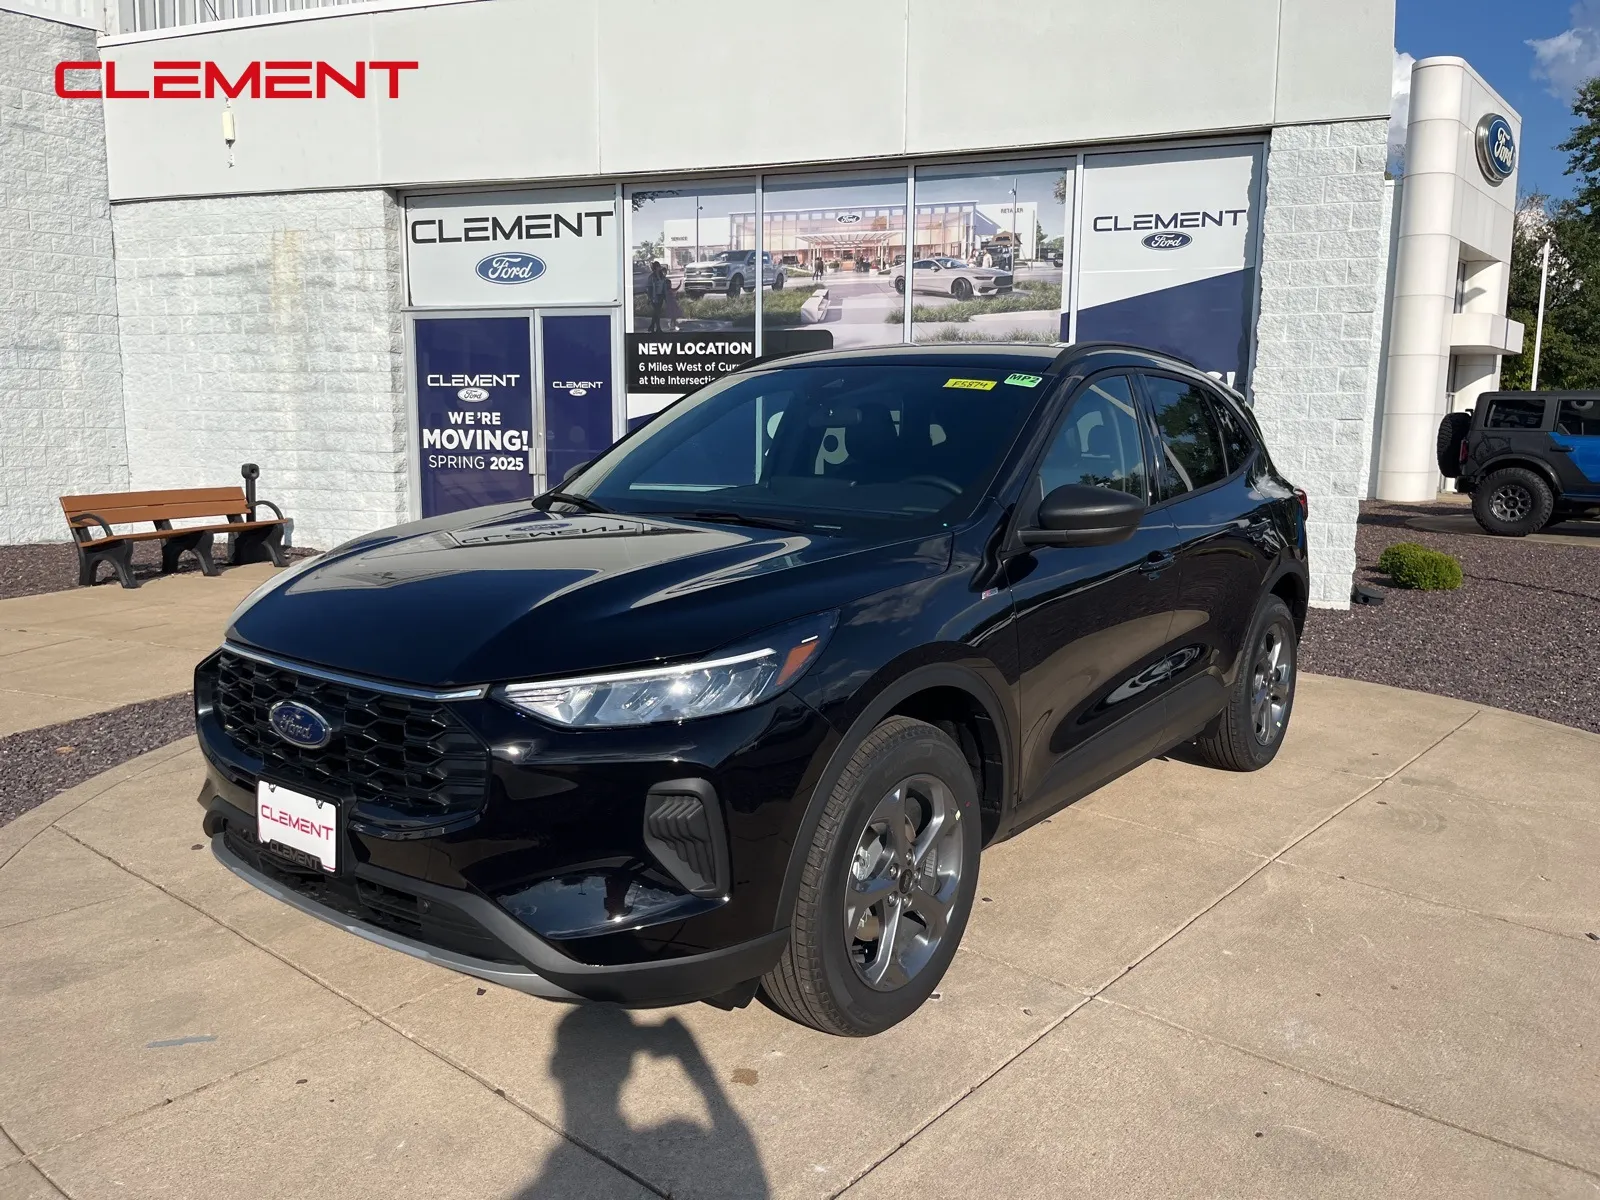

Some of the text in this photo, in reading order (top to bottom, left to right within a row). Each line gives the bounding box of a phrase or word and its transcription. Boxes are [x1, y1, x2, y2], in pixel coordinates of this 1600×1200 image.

[1494, 127, 1514, 168] Ford
[411, 211, 614, 244] CLEMENT
[1093, 209, 1247, 233] CLEMENT
[1151, 234, 1182, 248] Ford
[488, 256, 533, 279] Ford
[638, 342, 752, 355] NEW LOCATION
[639, 362, 646, 372] 6
[648, 362, 673, 372] Miles
[676, 362, 702, 372] West
[704, 361, 715, 372] of
[427, 374, 520, 387] CLEMENT
[552, 381, 604, 389] CLEMENT
[639, 376, 648, 385] at
[651, 375, 666, 385] the
[1009, 373, 1040, 384] MP2
[463, 389, 483, 400] Ford
[448, 411, 501, 425] WE'RE
[422, 428, 529, 452] MOVING!
[428, 455, 524, 471] SPRING 2025
[280, 711, 313, 740] Ford
[261, 804, 334, 841] CLEMENT
[270, 840, 319, 870] CLEMENT
